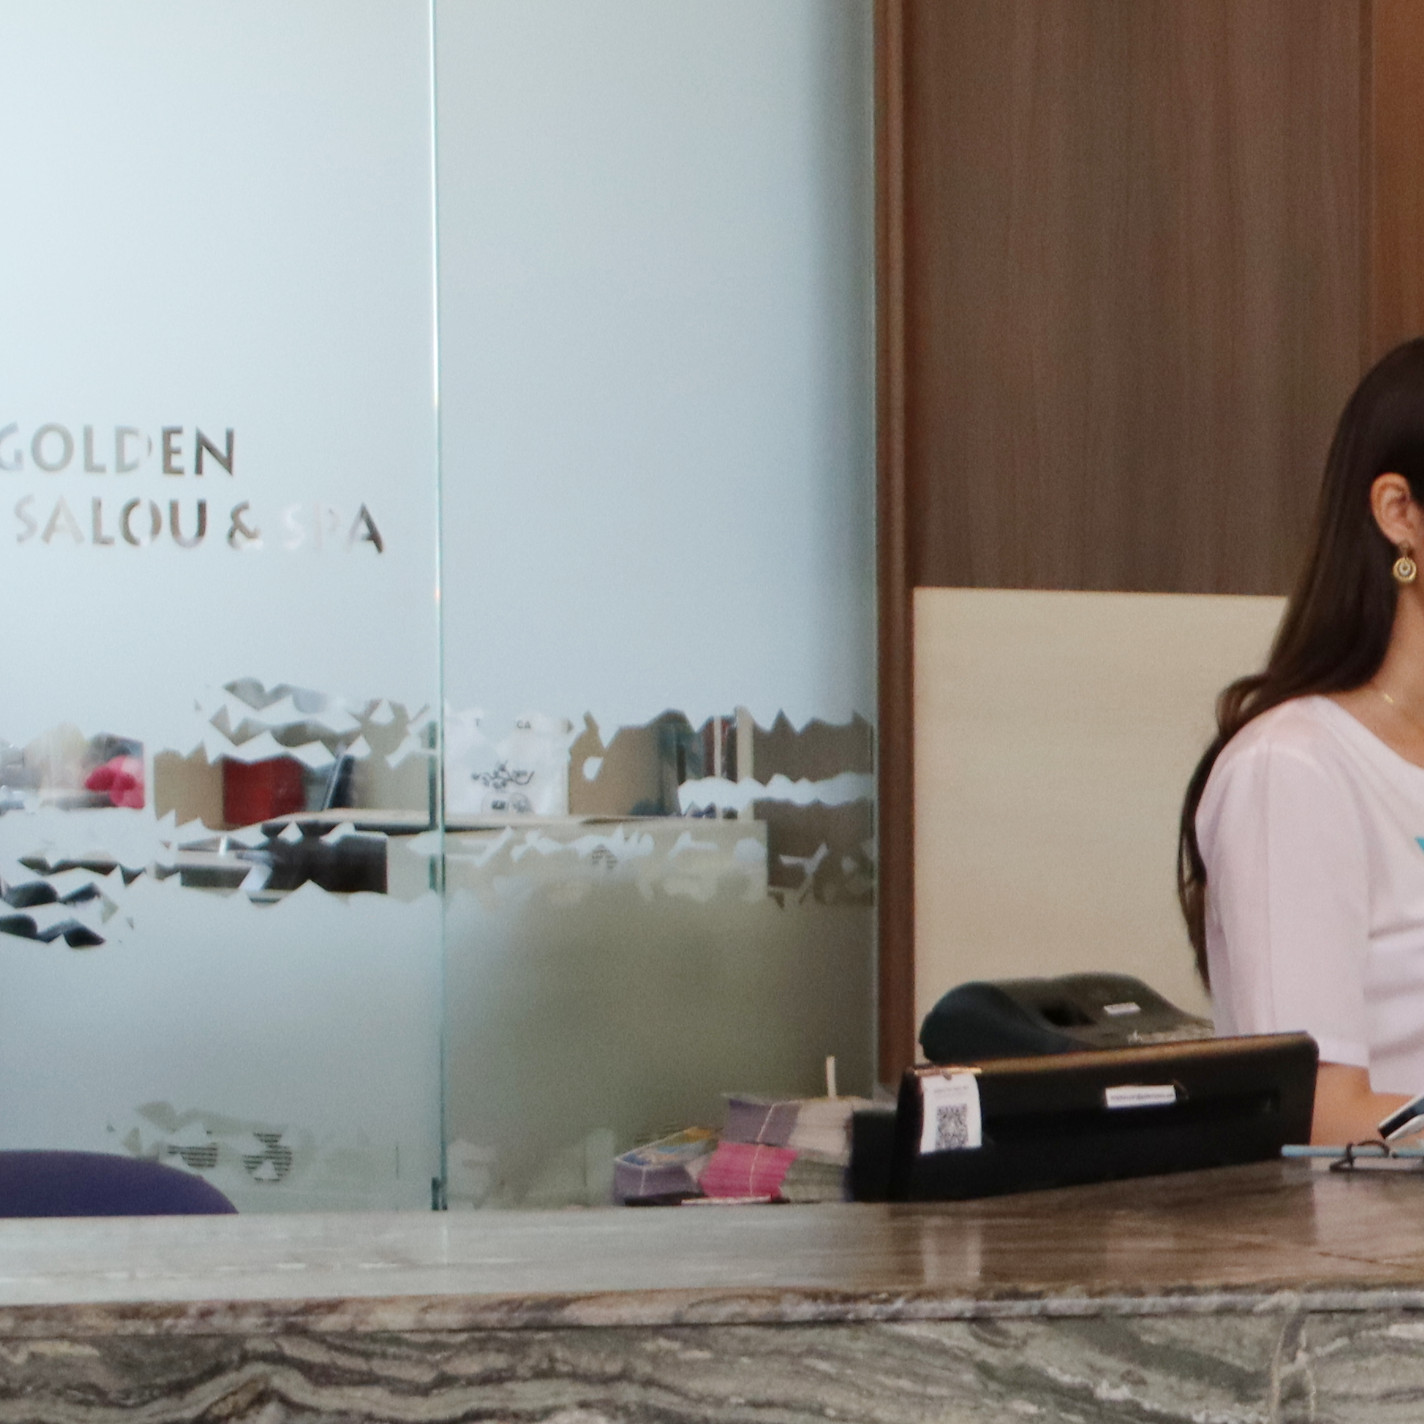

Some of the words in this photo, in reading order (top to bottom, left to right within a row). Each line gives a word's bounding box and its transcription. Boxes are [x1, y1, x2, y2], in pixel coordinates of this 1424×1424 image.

[0, 422, 235, 477] GOLDEN
[13, 494, 208, 549] SALOU
[227, 501, 263, 551] &
